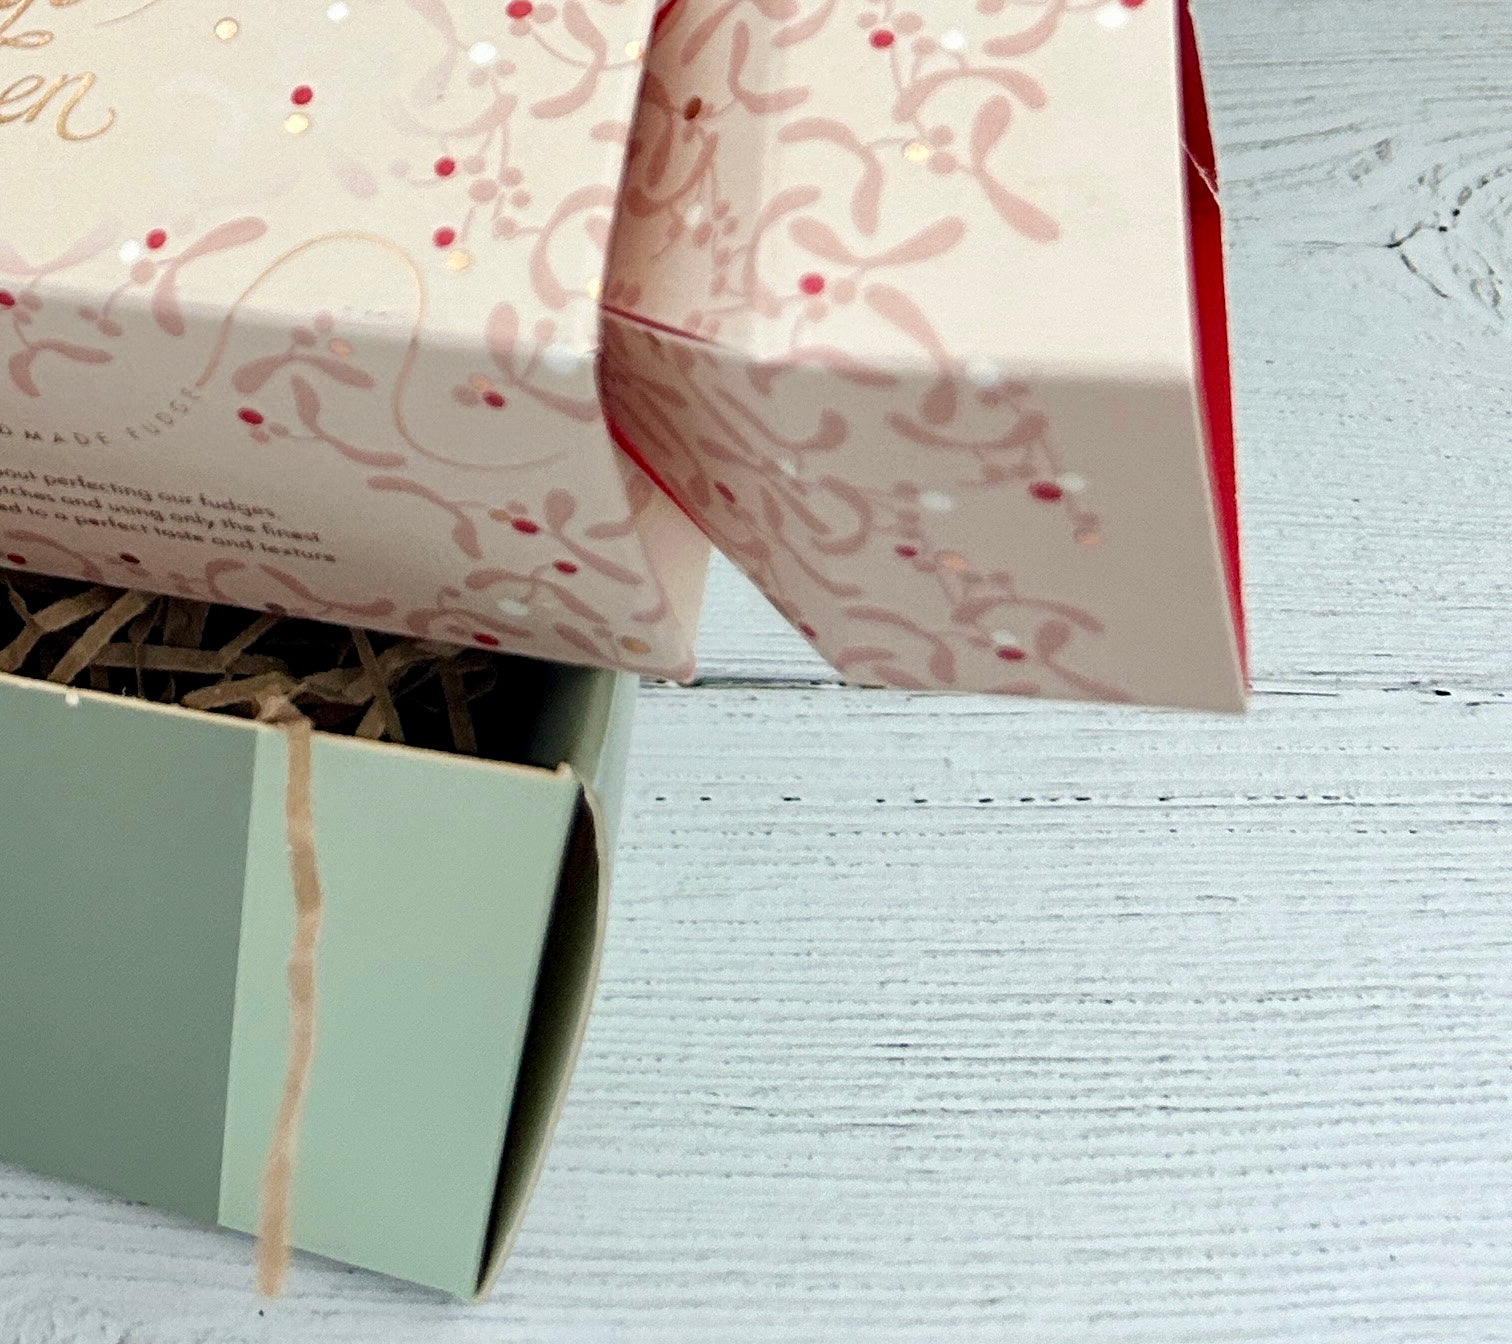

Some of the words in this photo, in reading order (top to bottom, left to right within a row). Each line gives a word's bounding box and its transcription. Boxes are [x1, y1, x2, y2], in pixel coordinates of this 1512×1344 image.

[43, 473, 153, 504] perfecting
[158, 489, 192, 506] our
[26, 503, 49, 520] to
[54, 511, 69, 522] a
[211, 535, 255, 552] and
[60, 492, 103, 511] and
[108, 501, 164, 524] using
[169, 511, 215, 531] only
[221, 516, 256, 534] the
